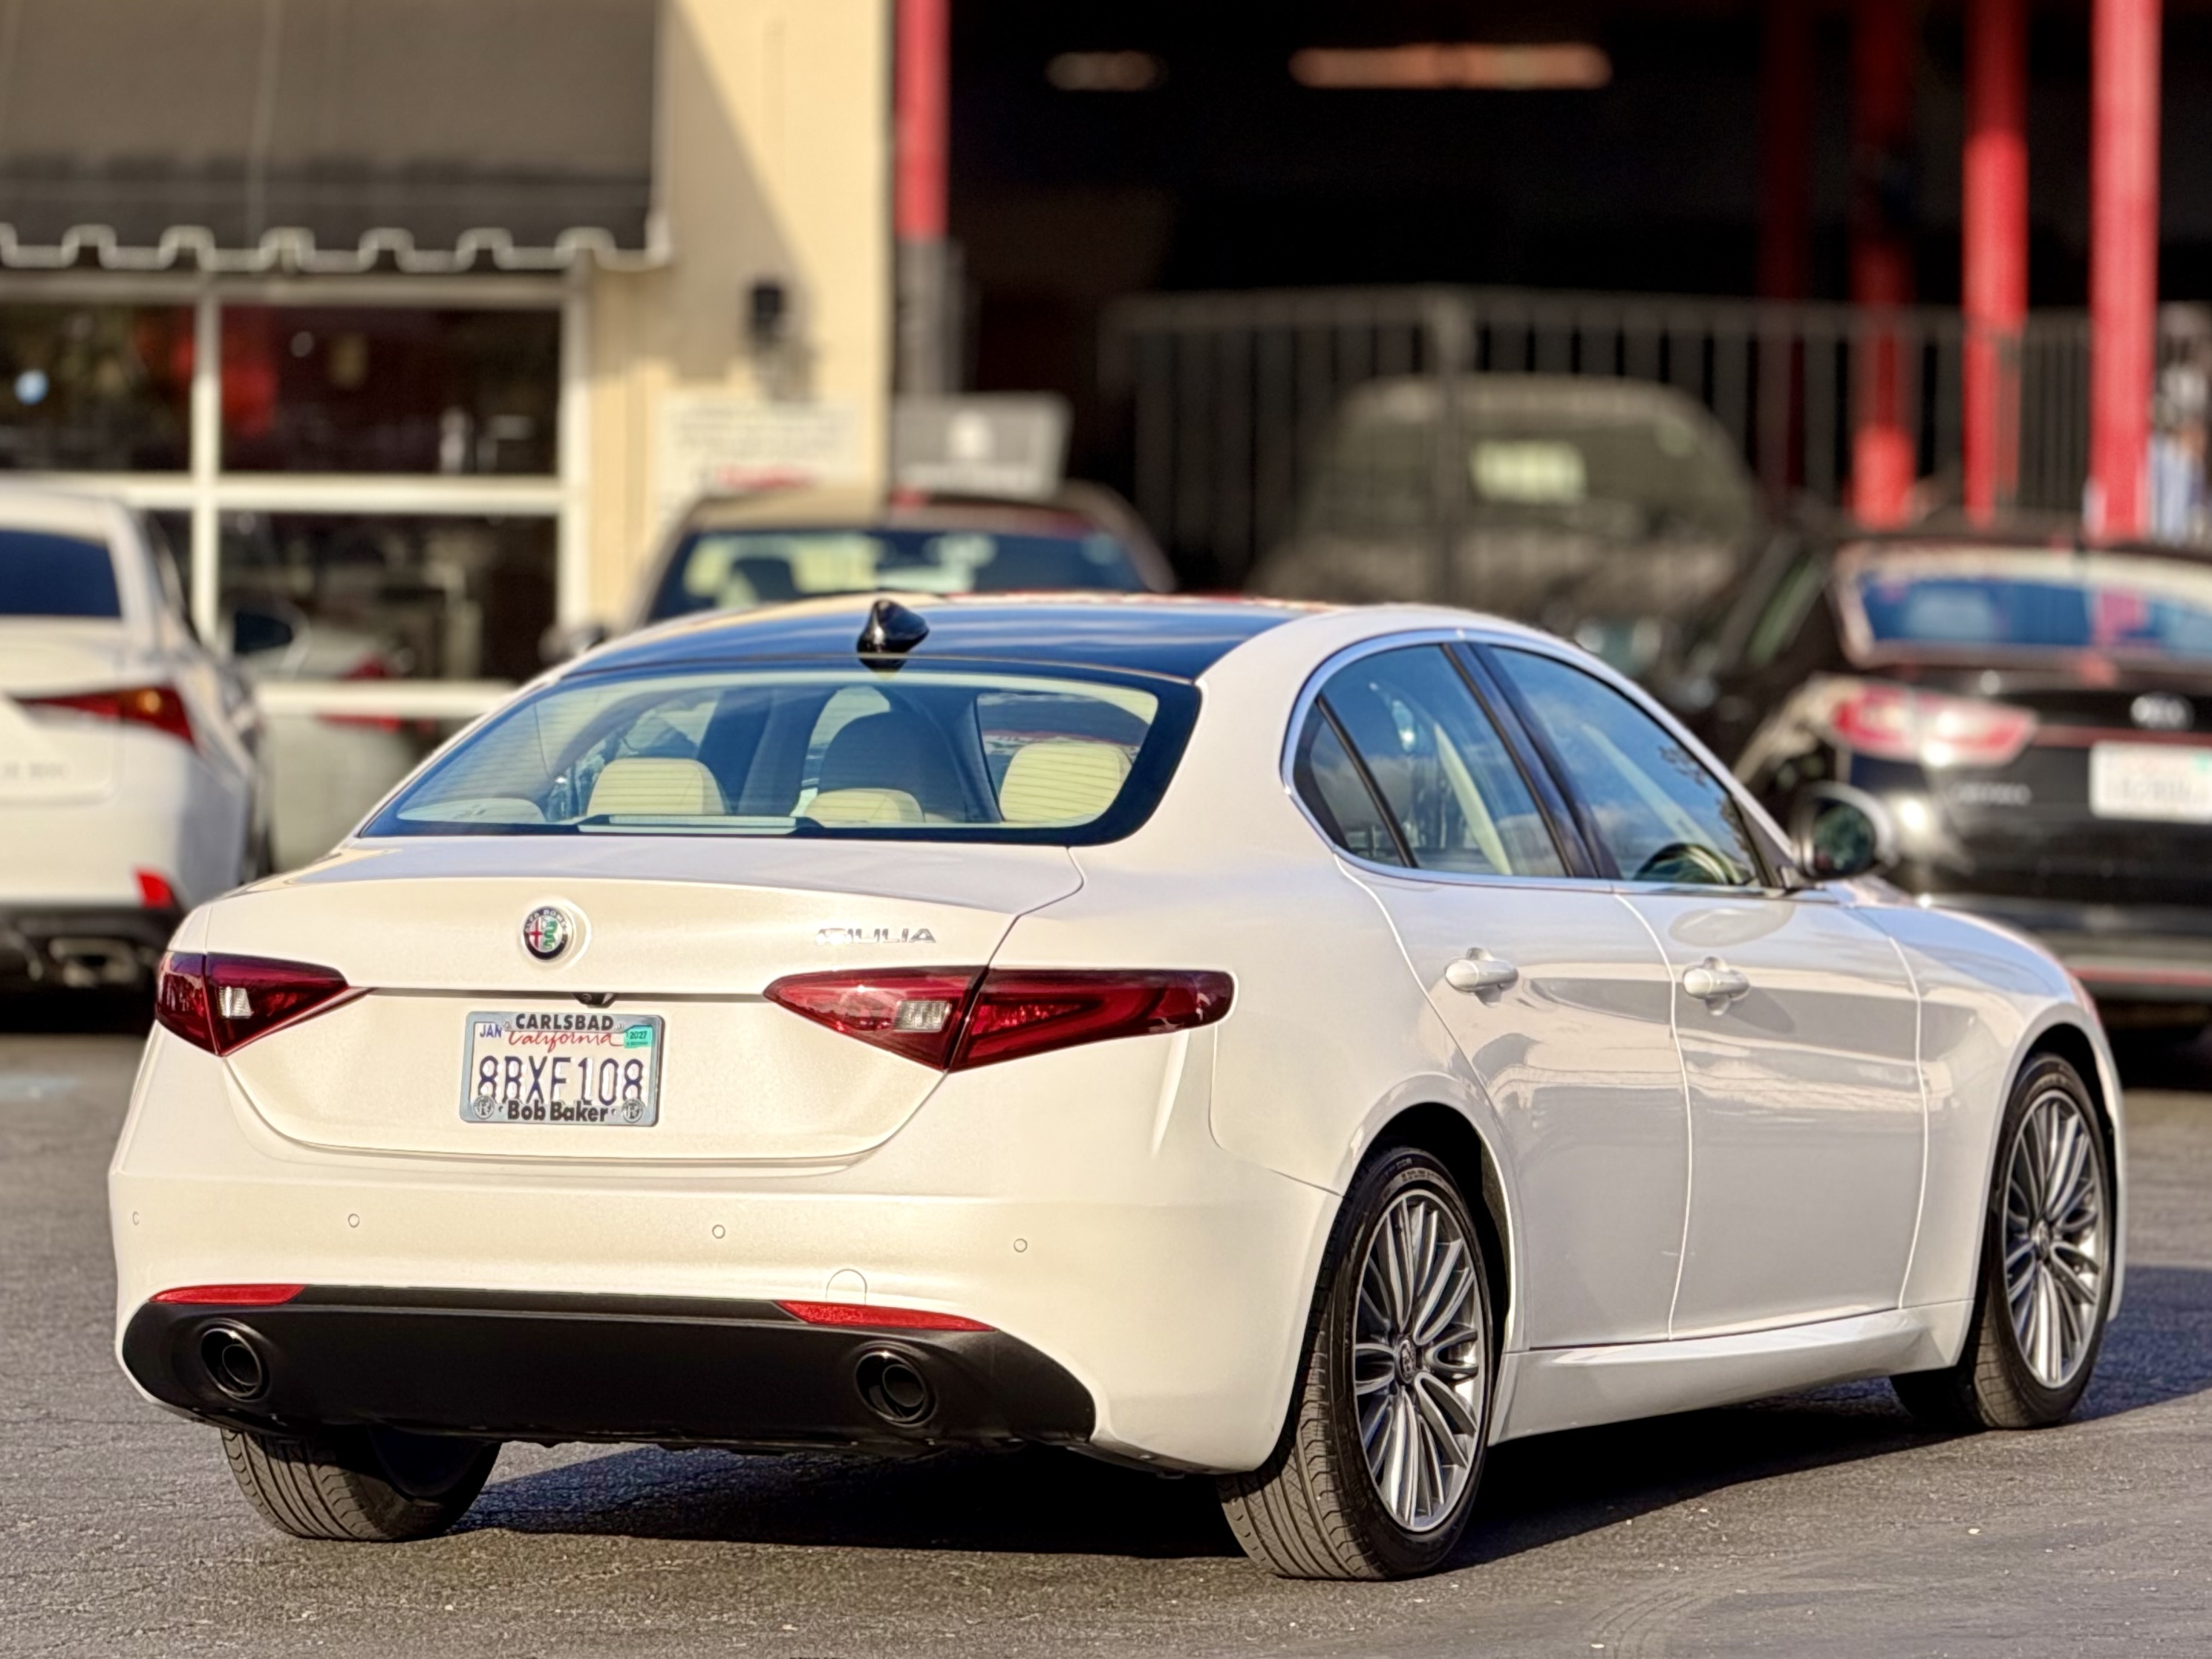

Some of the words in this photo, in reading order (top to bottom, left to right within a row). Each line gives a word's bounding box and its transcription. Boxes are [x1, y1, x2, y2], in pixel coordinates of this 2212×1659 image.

[480, 1023, 502, 1038] JAN
[515, 1013, 615, 1031] CARLSBAD
[509, 1030, 624, 1054] California
[477, 1055, 644, 1106] 8BXF108
[507, 1099, 547, 1121] Bob
[549, 1099, 609, 1122] Baker
